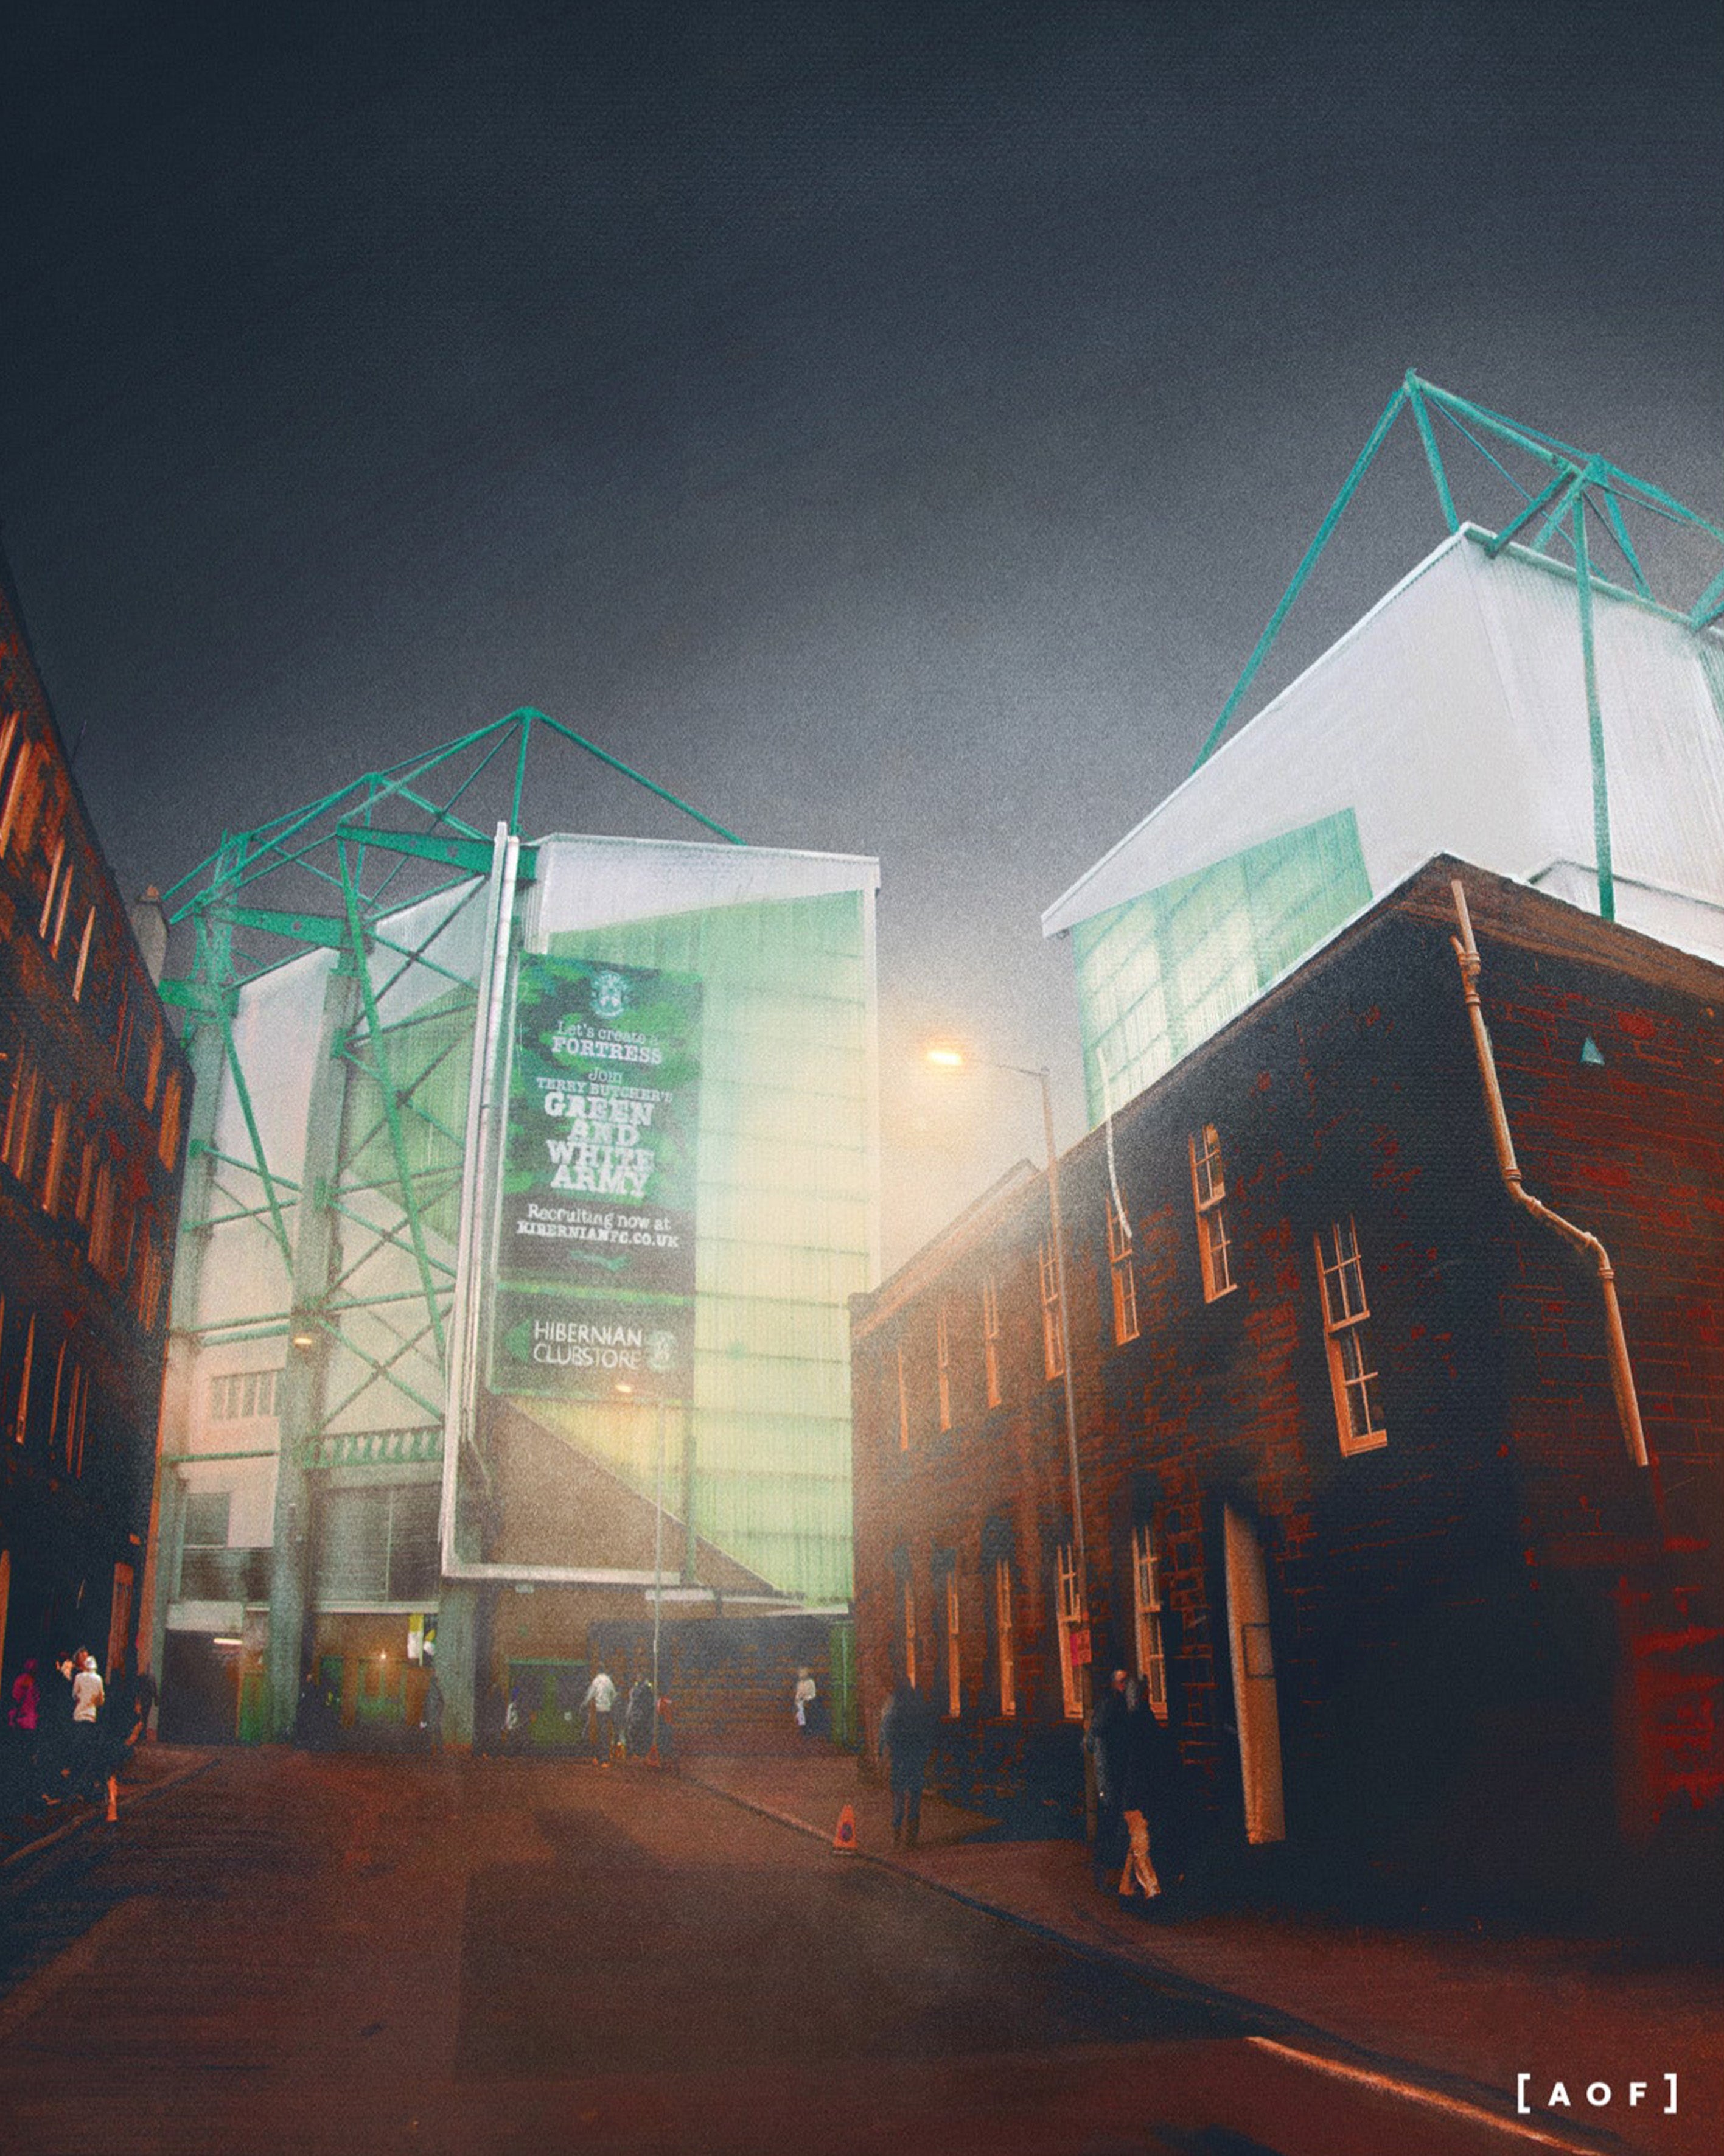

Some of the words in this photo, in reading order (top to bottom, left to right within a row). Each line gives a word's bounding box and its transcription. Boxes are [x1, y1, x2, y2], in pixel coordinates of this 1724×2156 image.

[551, 1036, 663, 1064] FORTRESS
[536, 1077, 587, 1093] TERRY
[544, 1092, 655, 1126] GREEN
[568, 1120, 640, 1147] AND
[546, 1139, 655, 1173] WHITE
[550, 1165, 651, 1198] ARMY
[528, 1203, 613, 1230] Recruiting
[618, 1216, 651, 1229] now
[654, 1216, 671, 1231] at
[534, 1320, 643, 1347] HIBERNIAN
